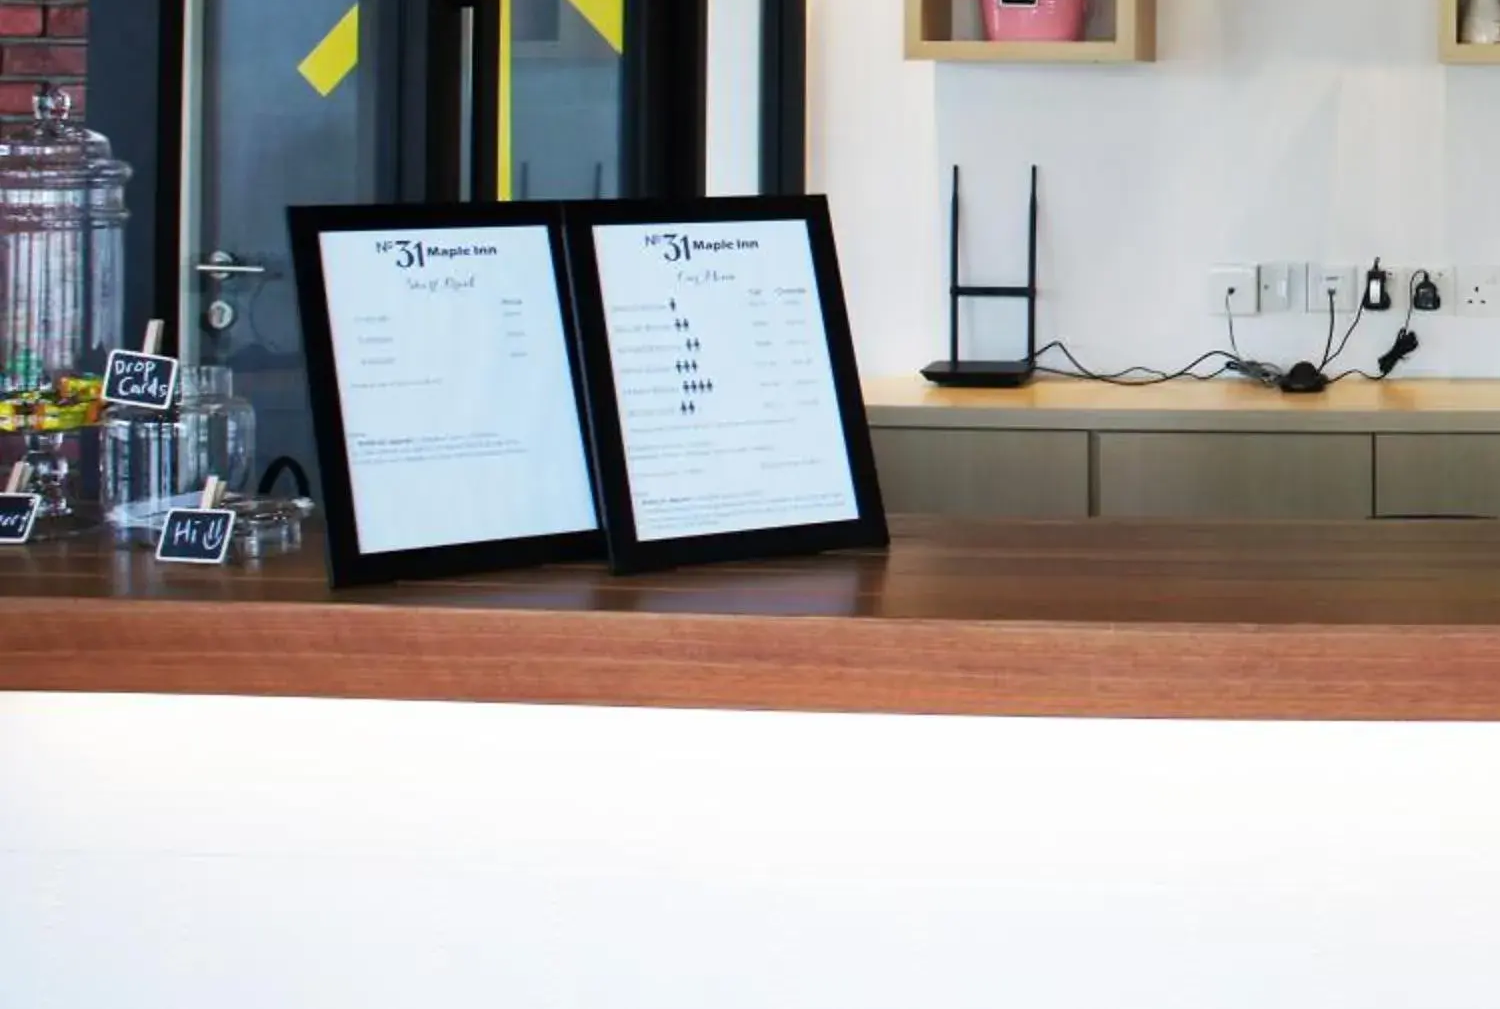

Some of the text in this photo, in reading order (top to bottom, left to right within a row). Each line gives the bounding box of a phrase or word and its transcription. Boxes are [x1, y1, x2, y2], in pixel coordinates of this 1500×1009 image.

[395, 240, 425, 268] 31
[427, 246, 470, 258] Maple
[473, 245, 498, 256] Inn
[663, 234, 691, 262] 31
[692, 240, 734, 252] Maple
[737, 239, 759, 250] Inn
[115, 360, 156, 382] Drop
[119, 377, 168, 398] Cards
